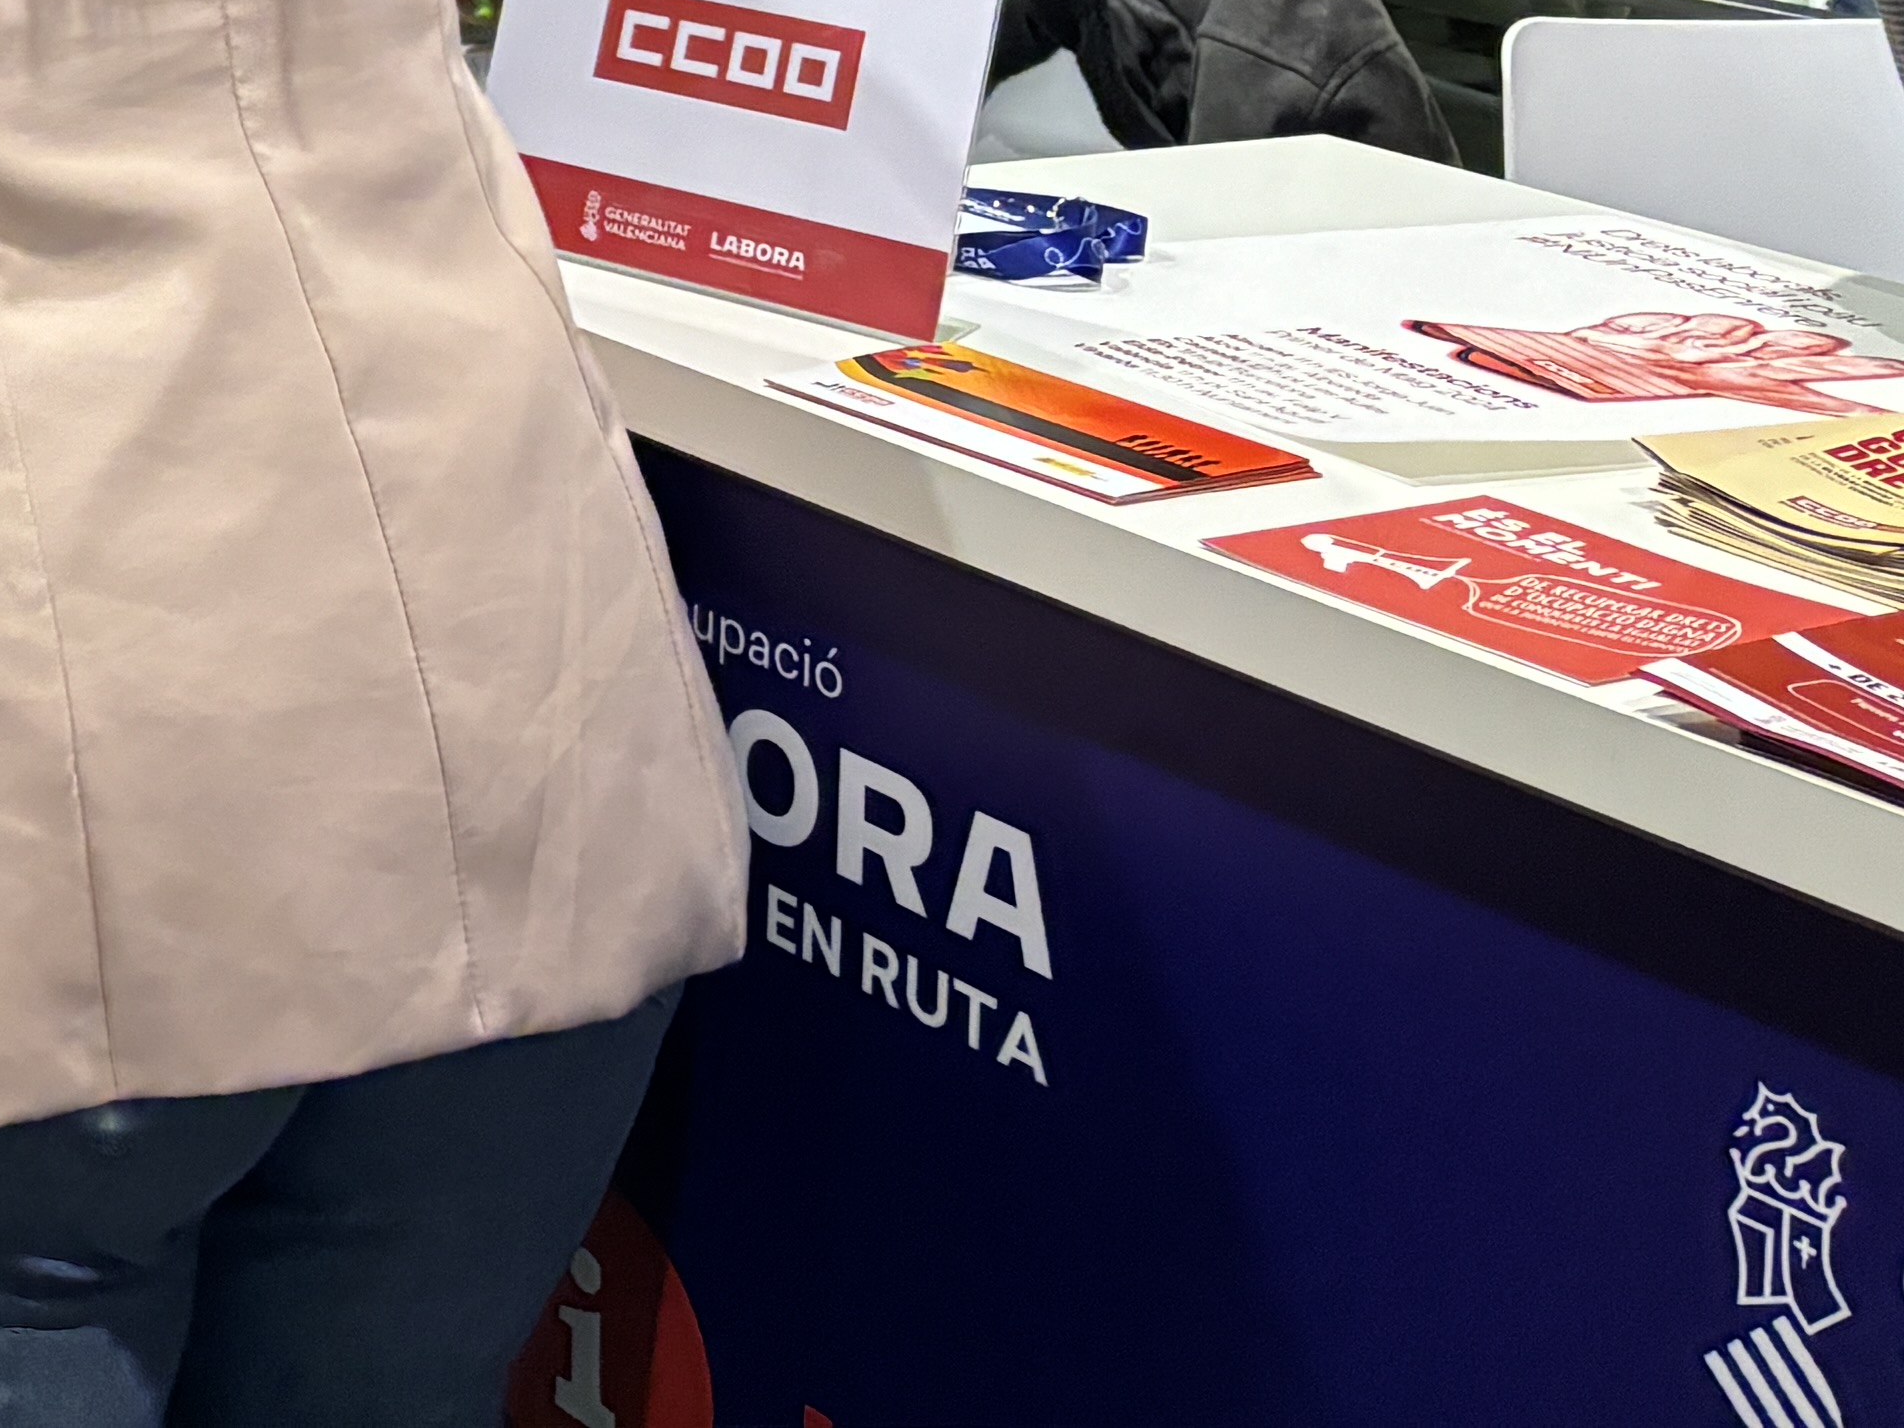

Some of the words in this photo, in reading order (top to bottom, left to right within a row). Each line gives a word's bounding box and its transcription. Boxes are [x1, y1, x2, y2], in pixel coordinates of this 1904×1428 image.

[616, 8, 842, 104] CCOO
[603, 220, 687, 252] VALENCIANA
[604, 205, 692, 237] GENERALITAT
[708, 230, 806, 272] LABORA
[1295, 327, 1540, 409] Manifestacions
[1528, 531, 1587, 556] EL
[1635, 619, 1717, 644] DIGNA
[766, 883, 842, 978] EN
[861, 932, 1050, 1088] RUTA
